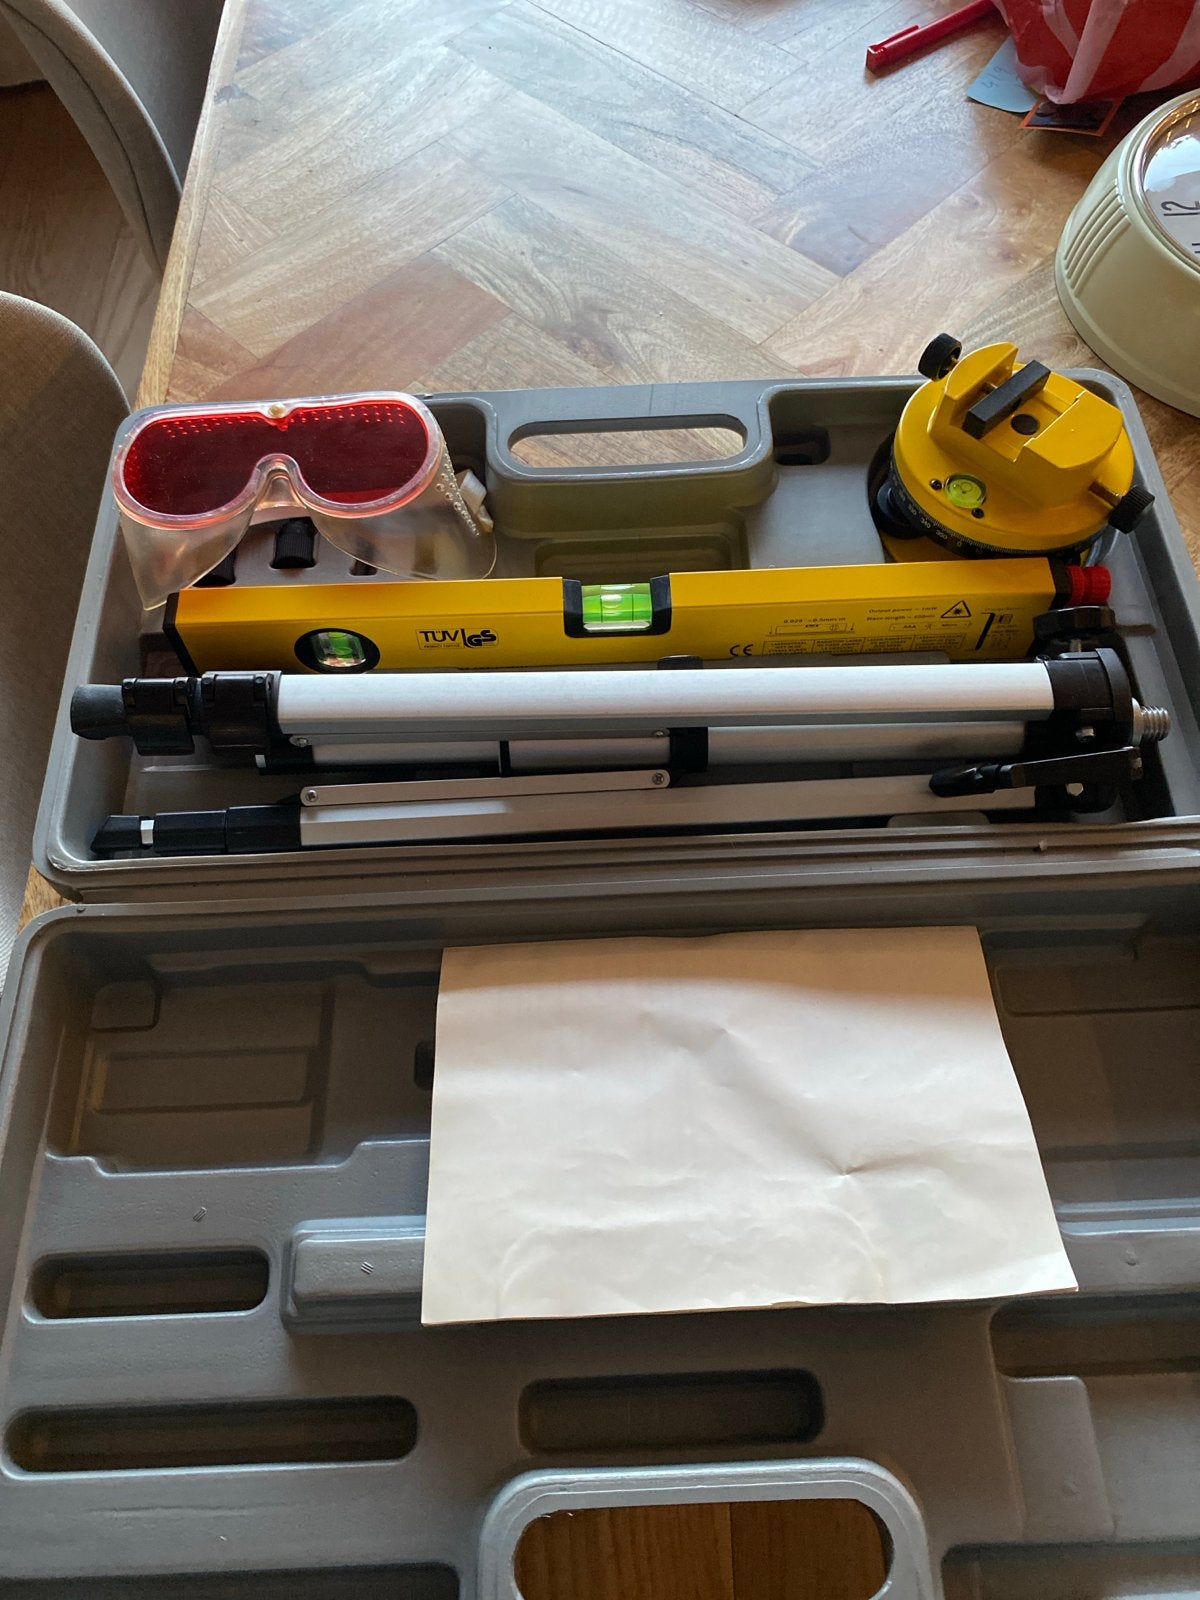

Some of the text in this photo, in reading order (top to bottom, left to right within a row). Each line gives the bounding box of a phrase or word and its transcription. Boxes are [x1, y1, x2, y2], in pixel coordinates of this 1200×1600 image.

[419, 629, 497, 647] TÜV GS
[729, 643, 754, 657] CE
